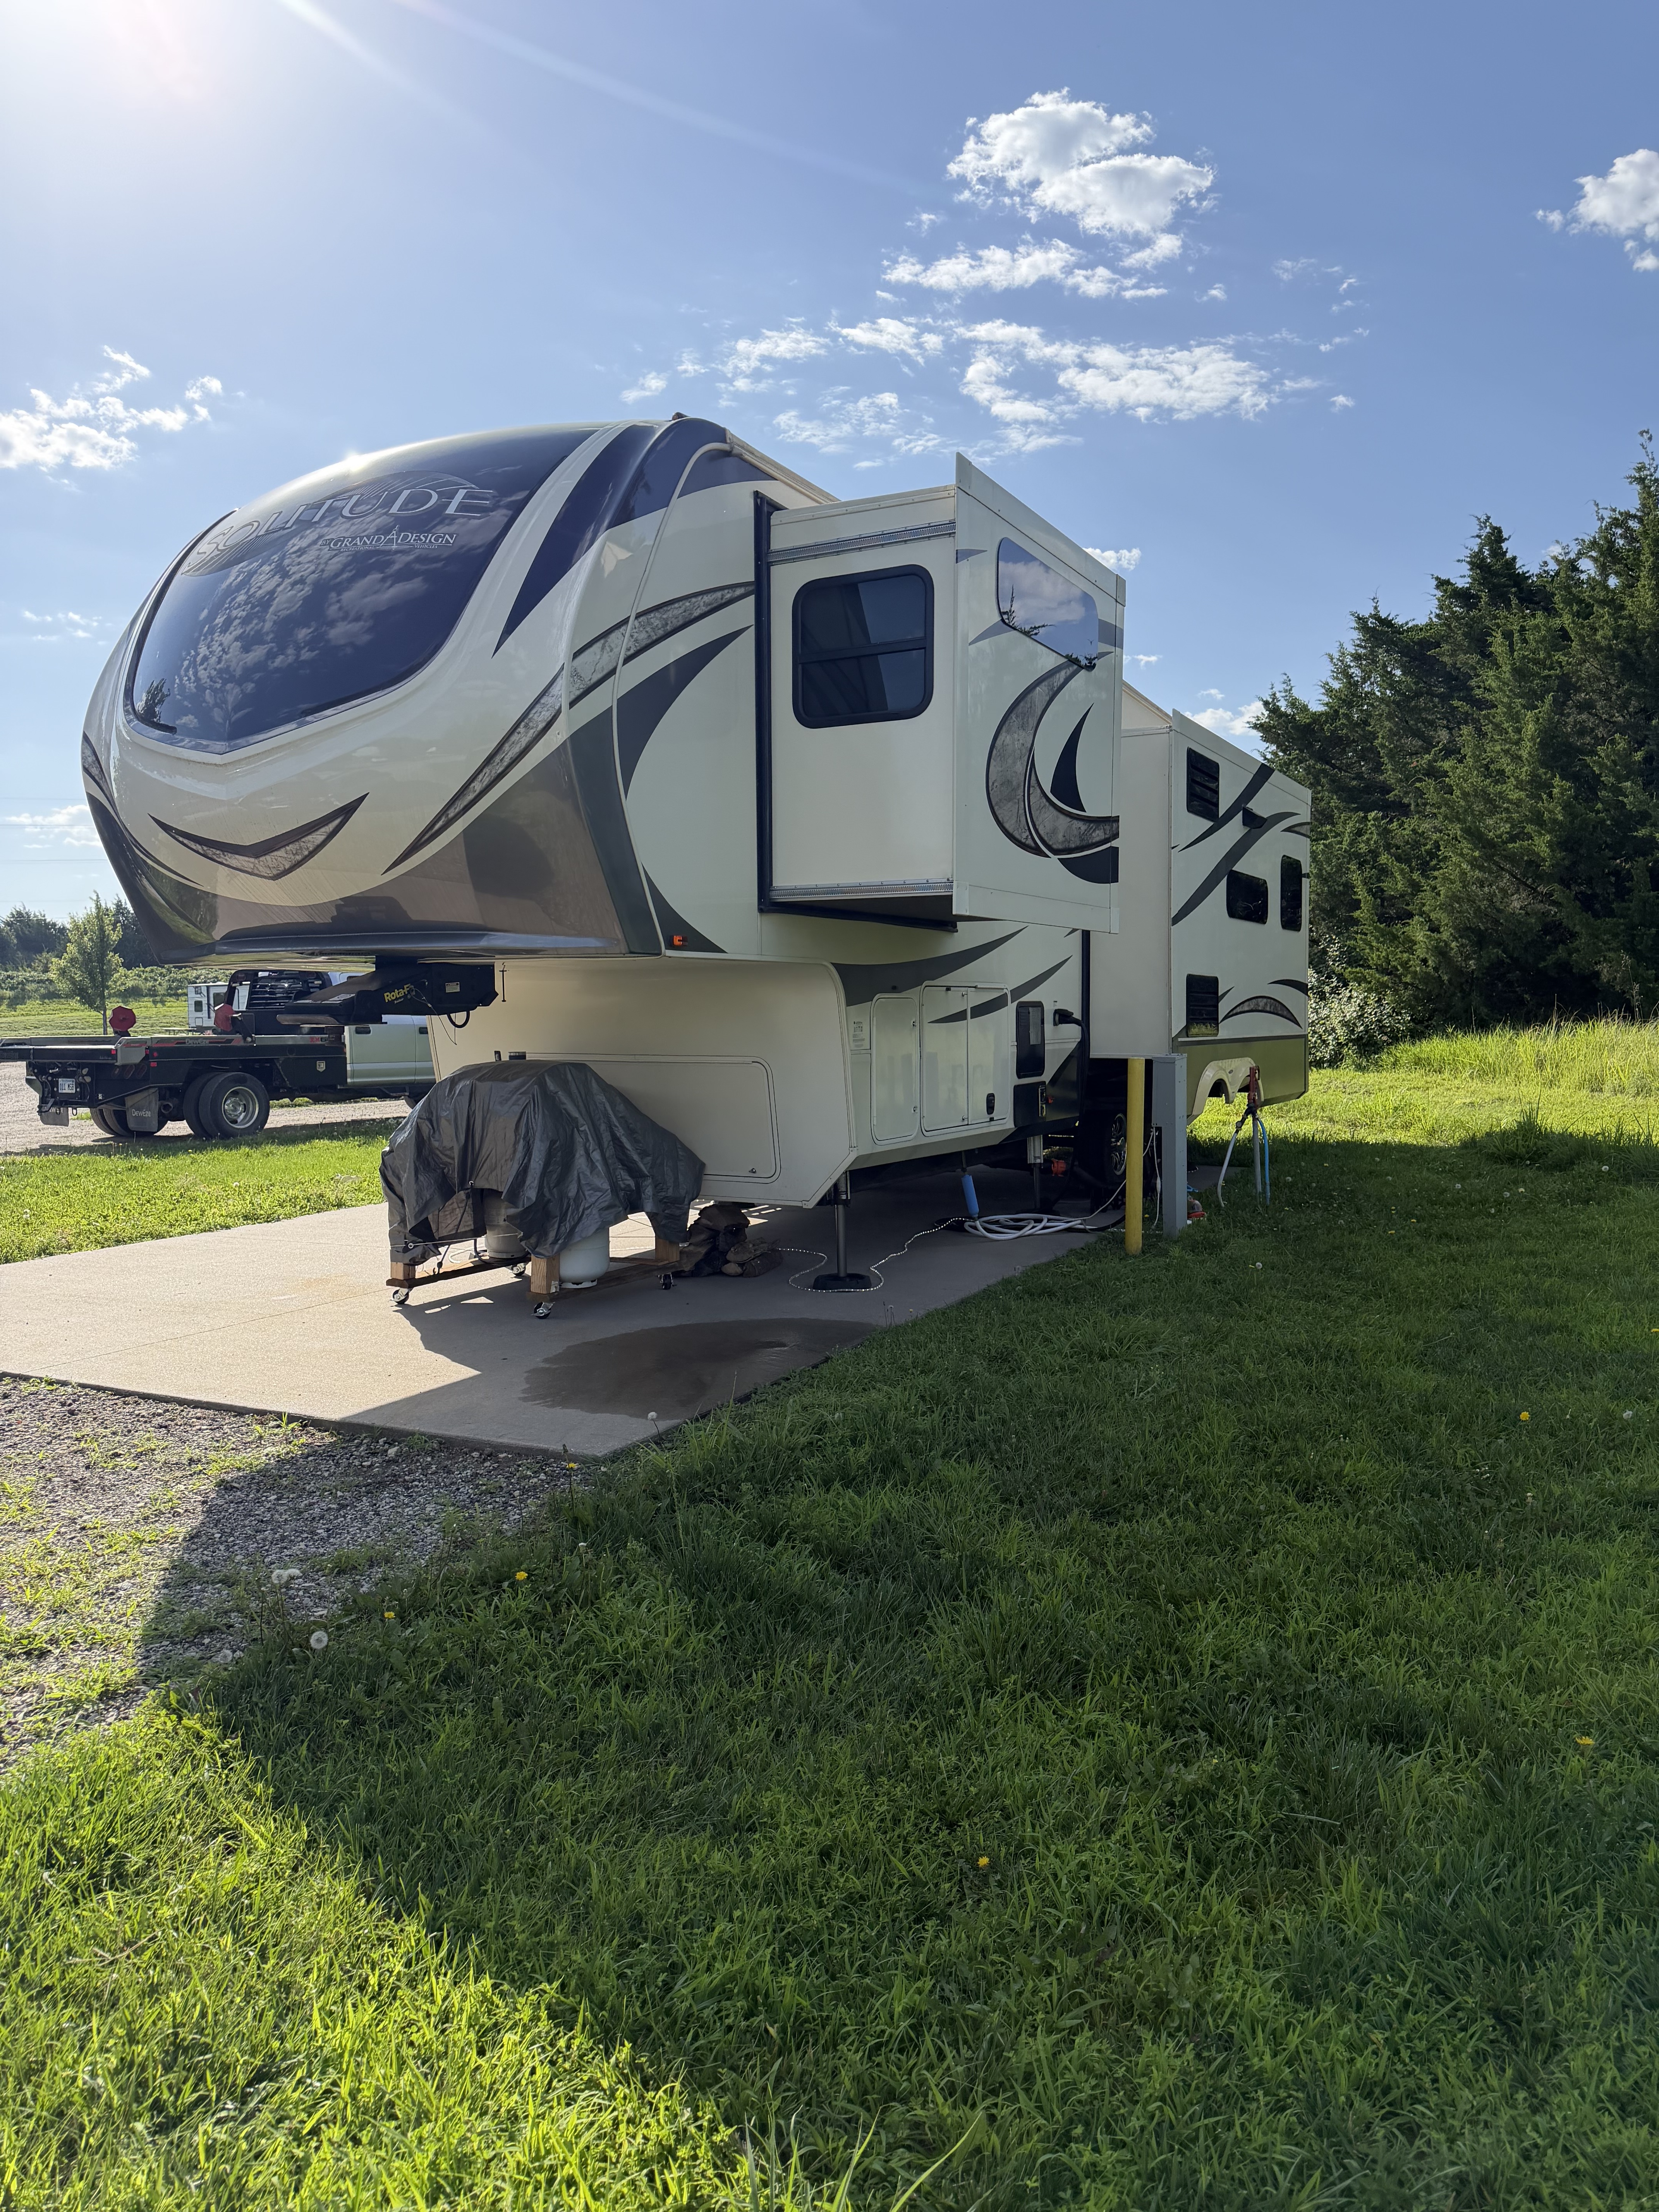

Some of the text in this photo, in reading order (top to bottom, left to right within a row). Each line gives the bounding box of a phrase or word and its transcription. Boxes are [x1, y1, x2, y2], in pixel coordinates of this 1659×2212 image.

[182, 489, 493, 574] SOLITUDE
[330, 535, 384, 548] GRAND
[397, 532, 457, 544] DESIGN
